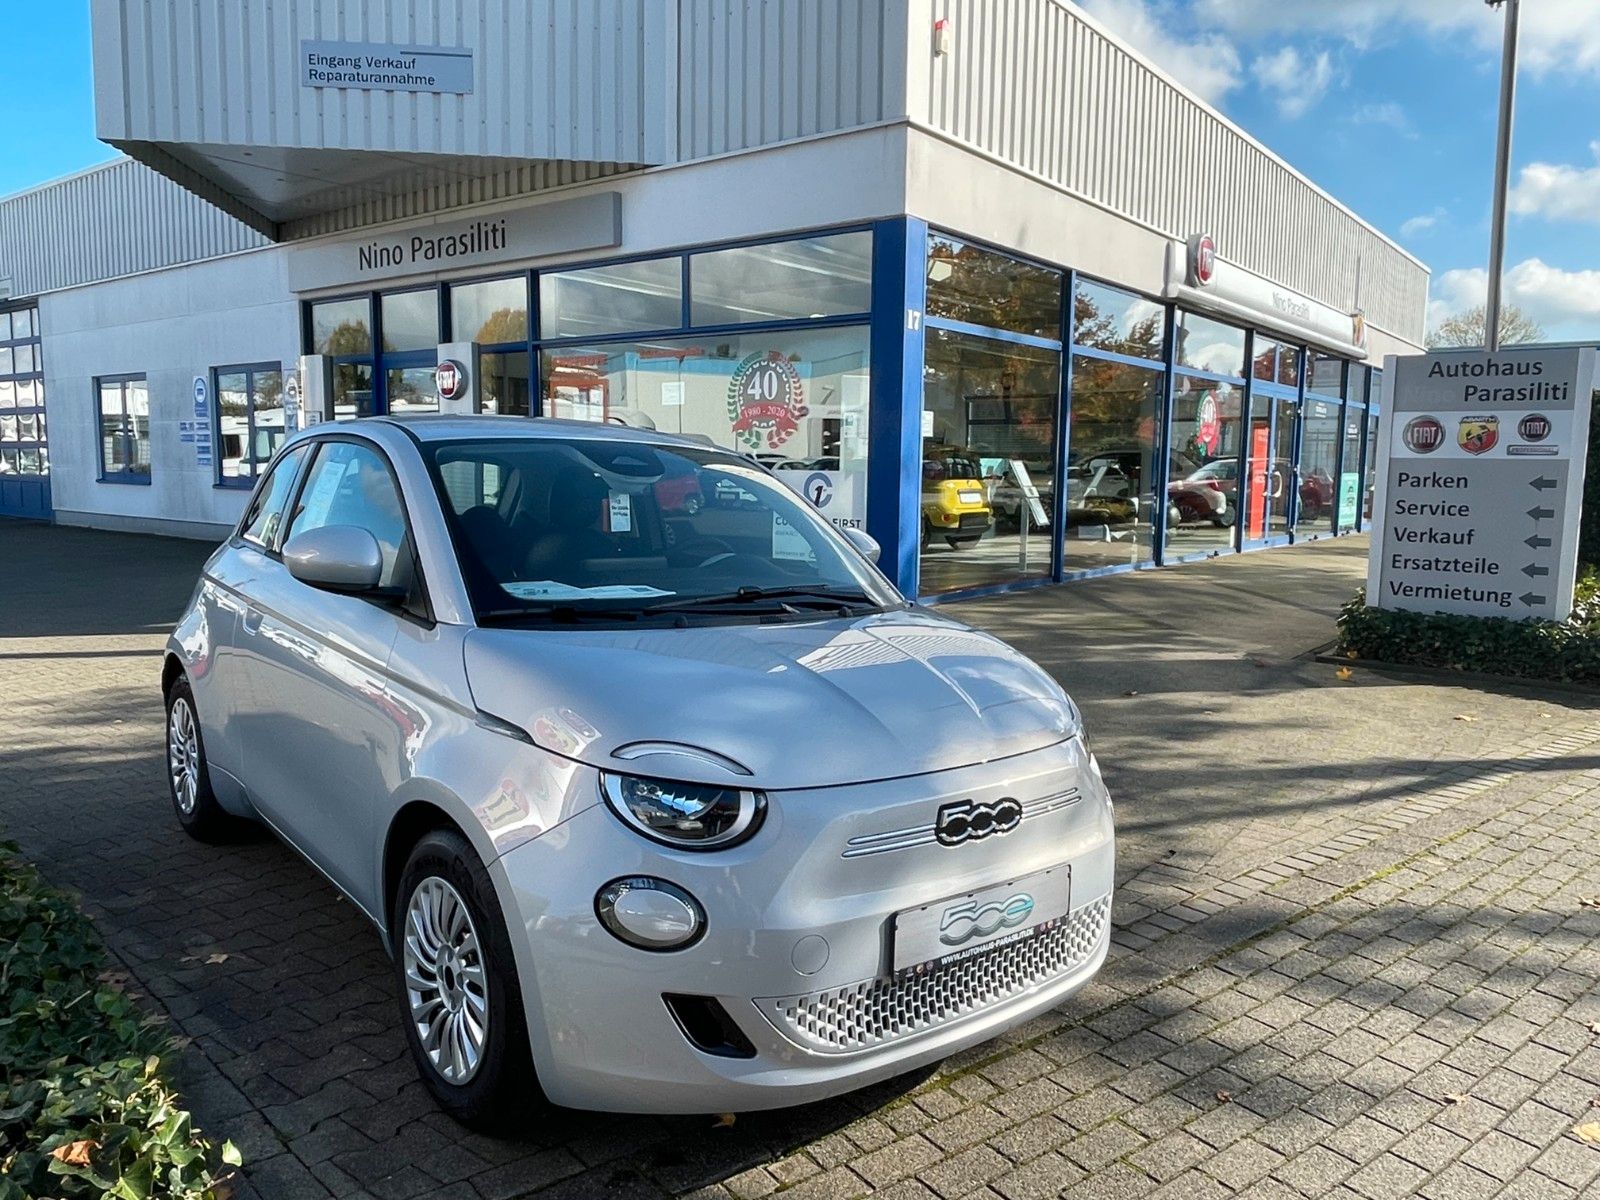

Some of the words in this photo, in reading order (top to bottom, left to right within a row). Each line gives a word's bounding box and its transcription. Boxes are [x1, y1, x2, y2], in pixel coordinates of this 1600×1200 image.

[308, 53, 362, 69] Eingang
[365, 56, 416, 70] Verkauf
[308, 69, 435, 86] Reparaturannahme
[359, 242, 403, 271] Nino
[411, 219, 506, 262] Parasiliti
[1428, 358, 1543, 378] Autohaus
[747, 370, 778, 400] 40
[1464, 382, 1568, 402] Parasiliti
[1413, 426, 1438, 445] FIAT
[1526, 422, 1545, 435] FIAT
[1398, 471, 1468, 489] Parken
[1395, 499, 1470, 517] Service
[832, 518, 861, 528] FIRST
[1394, 527, 1475, 545] Verkauf
[1392, 554, 1499, 575] Ersatzteile
[1389, 581, 1512, 608] Vermietung
[935, 797, 1023, 847] 500
